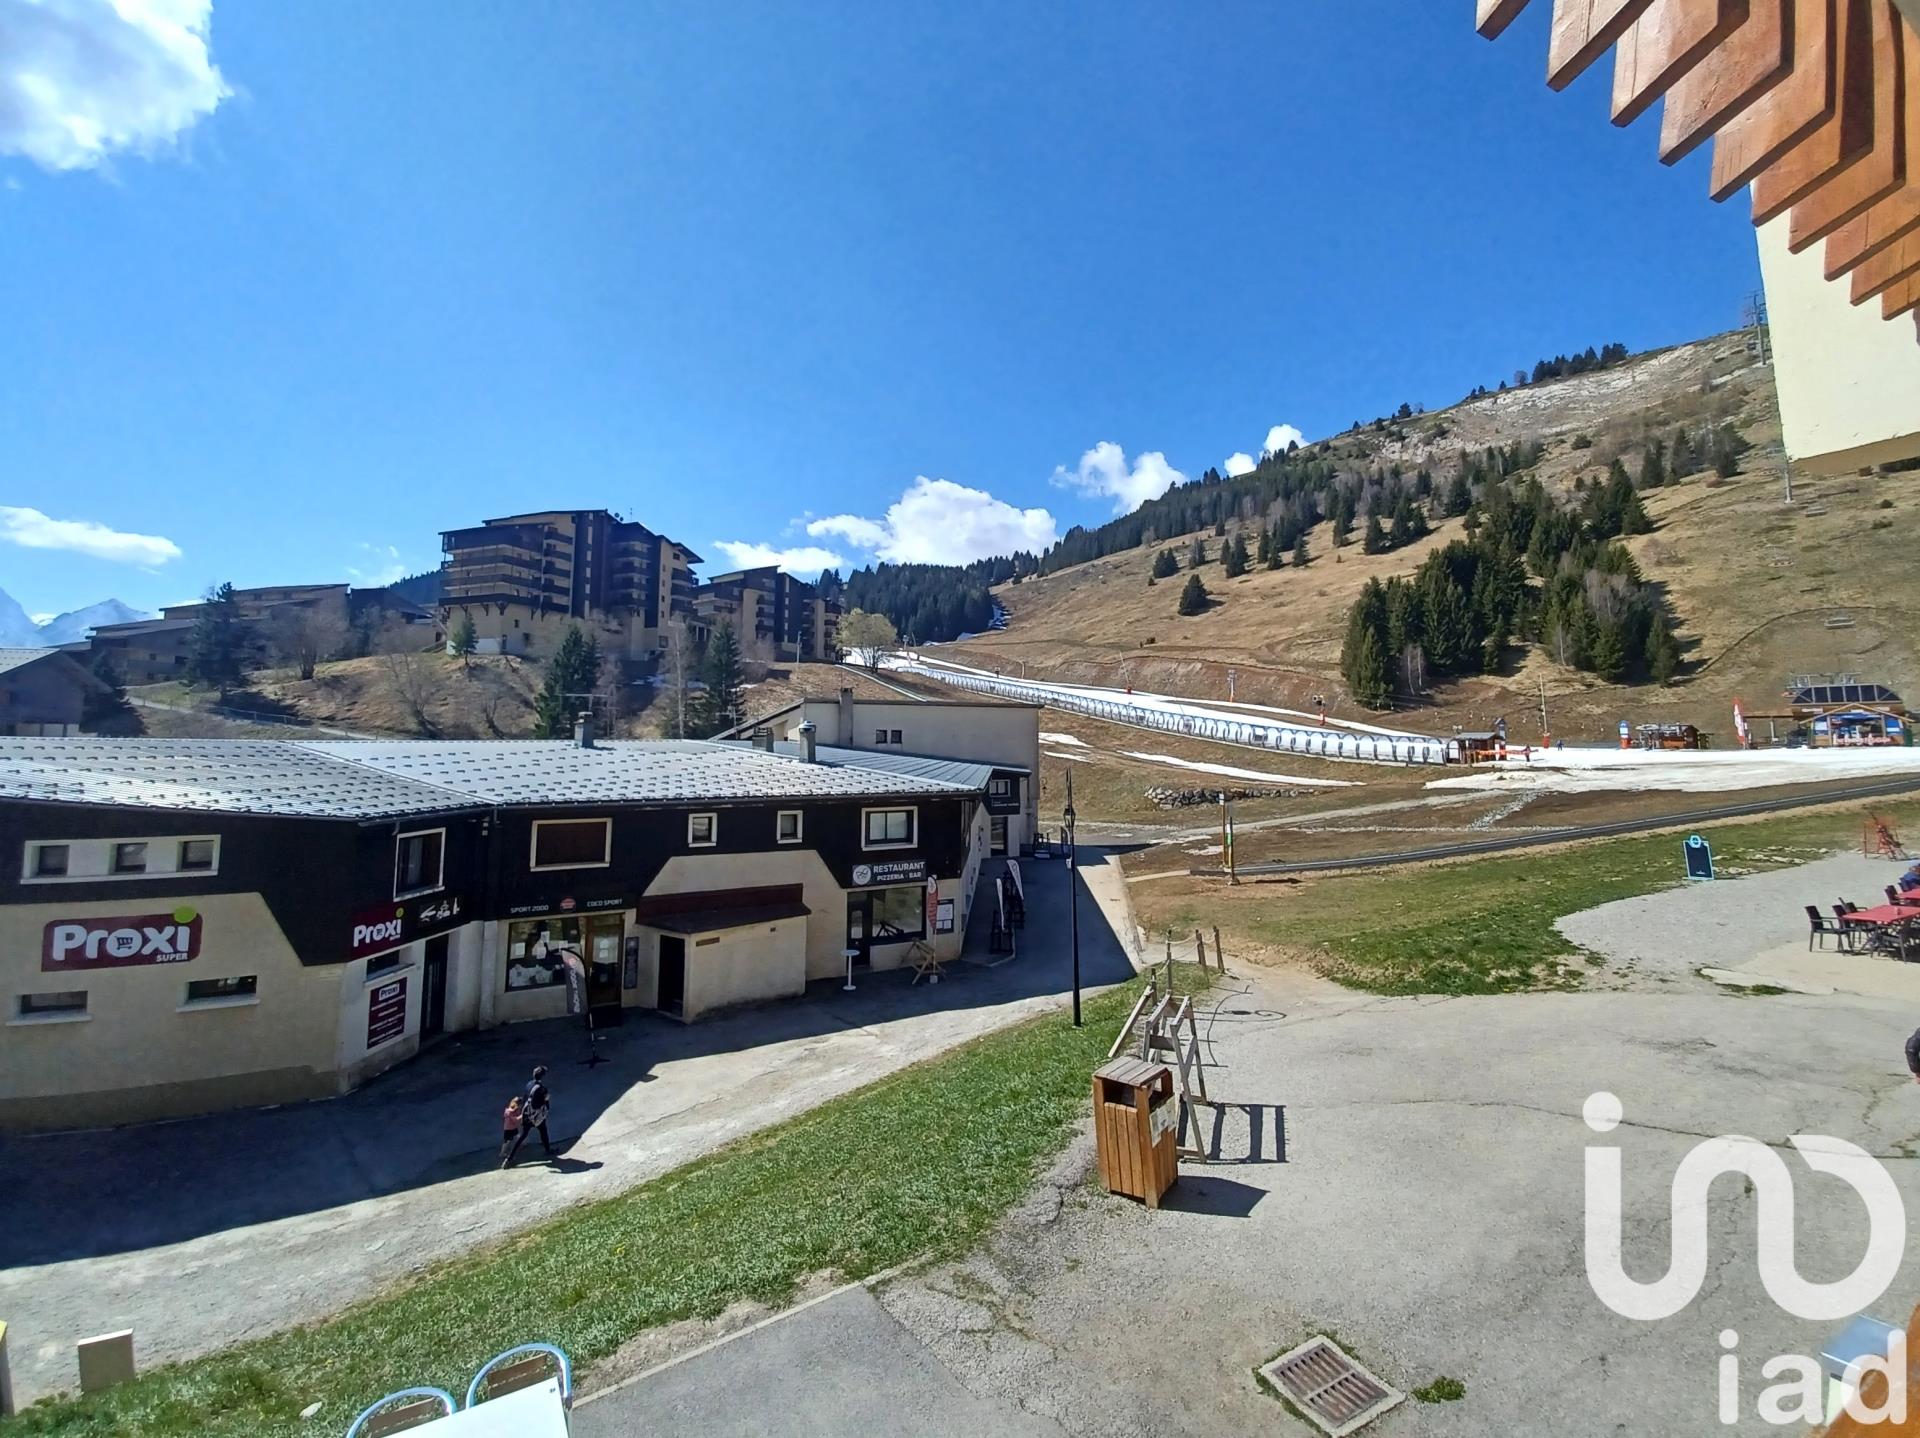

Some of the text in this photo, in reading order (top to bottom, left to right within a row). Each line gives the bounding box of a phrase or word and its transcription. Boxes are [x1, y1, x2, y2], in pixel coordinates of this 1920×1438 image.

[873, 861, 925, 873] RESTAURANT
[877, 873, 904, 881] PIZZERIA
[510, 904, 549, 914] SPORT 2000
[156, 952, 188, 963] SUPER
